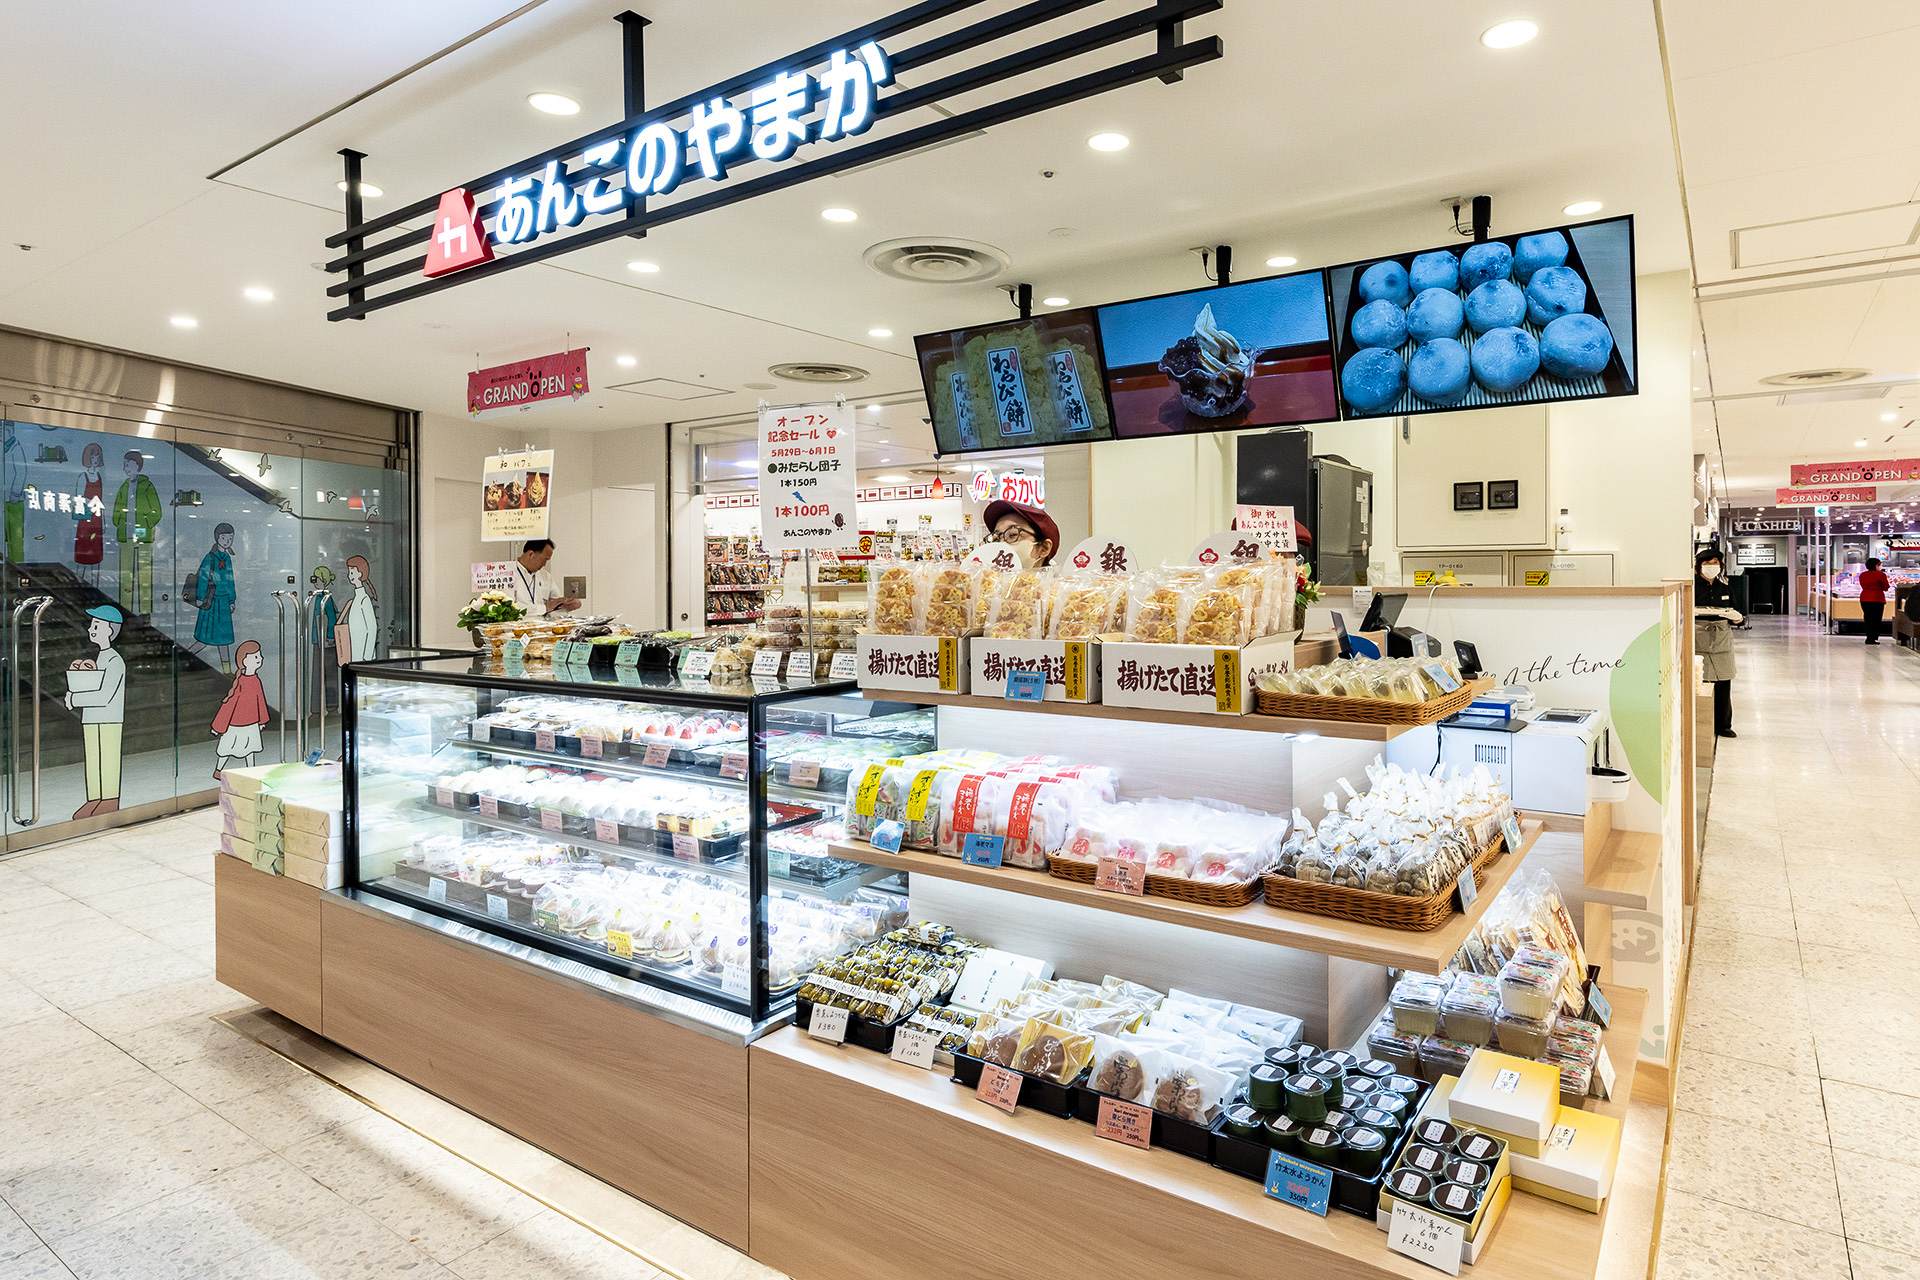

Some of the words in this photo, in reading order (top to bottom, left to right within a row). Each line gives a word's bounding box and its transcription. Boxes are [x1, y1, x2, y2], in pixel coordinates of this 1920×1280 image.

[495, 42, 890, 245] あんこのやまか
[483, 382, 529, 405] GRAND
[530, 373, 566, 398] OPEN
[991, 353, 1025, 428] わらび餅
[777, 414, 829, 427] オープン
[767, 429, 820, 443] 記念セール
[780, 478, 817, 487] 1本150円
[1810, 471, 1861, 484] GRAND
[1863, 469, 1902, 481] OPEN
[1002, 477, 1045, 505] おかし
[1790, 493, 1830, 504] GRAND
[1831, 493, 1861, 502] OPEN
[775, 504, 830, 518] 1本100円
[1251, 509, 1277, 519] 御祝
[783, 528, 833, 537] あんこのやまか
[1241, 520, 1288, 529] あんこのやまか様
[1100, 543, 1127, 573] 銀
[868, 648, 940, 680] 揚げたて直送
[1522, 655, 1563, 683] the
[1566, 653, 1626, 676] time
[1117, 659, 1217, 697] 揚げたて直送
[1275, 1163, 1326, 1187] 竹太水ようかん
[1286, 1181, 1310, 1198] 325円
[1289, 1192, 1308, 1205] 350円
